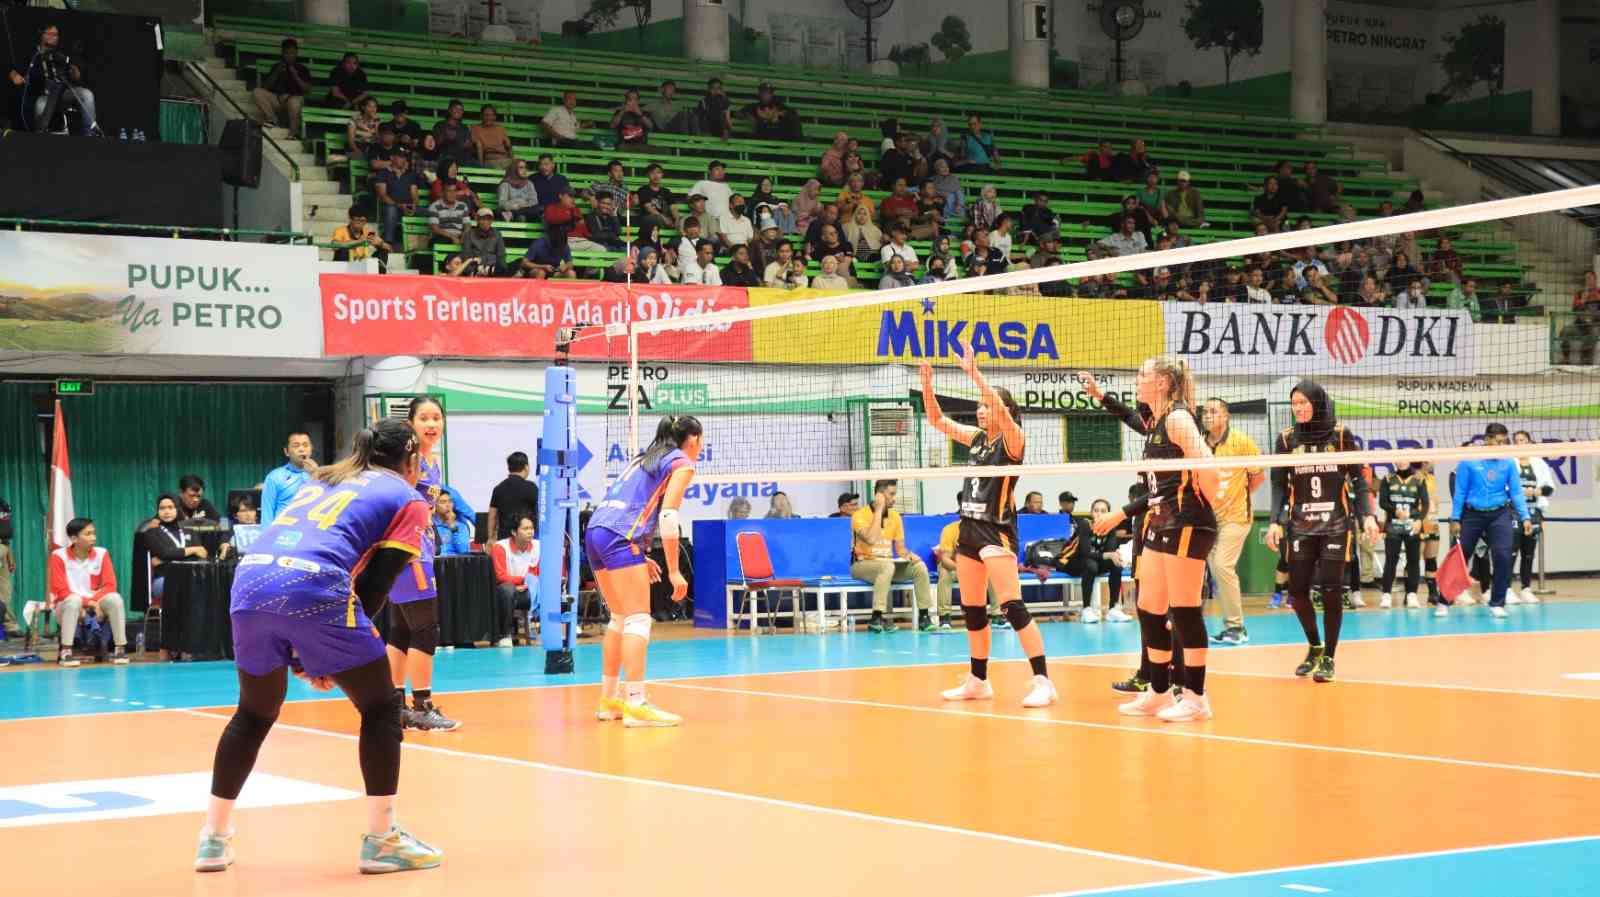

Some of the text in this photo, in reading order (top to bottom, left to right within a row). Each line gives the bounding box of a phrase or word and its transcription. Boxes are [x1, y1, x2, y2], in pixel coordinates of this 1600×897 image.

[1327, 30, 1426, 49] PETRO NINGRAT
[172, 302, 283, 330] PETRO
[334, 293, 417, 324] Sports
[423, 295, 556, 327] Terlengkap
[561, 298, 605, 325] Ada
[610, 300, 631, 325] di
[876, 299, 1060, 360] MIKASA
[1177, 310, 1460, 357] BANK DKI
[607, 366, 668, 381] PERO
[1025, 372, 1115, 385] PUPUK FOFAT
[60, 382, 80, 392] EXIT
[1397, 380, 1493, 393] PUPUK MAJEMUK
[656, 389, 705, 405] PLUS
[1398, 399, 1520, 416] PHONSKA ALAM
[1310, 475, 1322, 498] 9
[272, 485, 359, 531] 24
